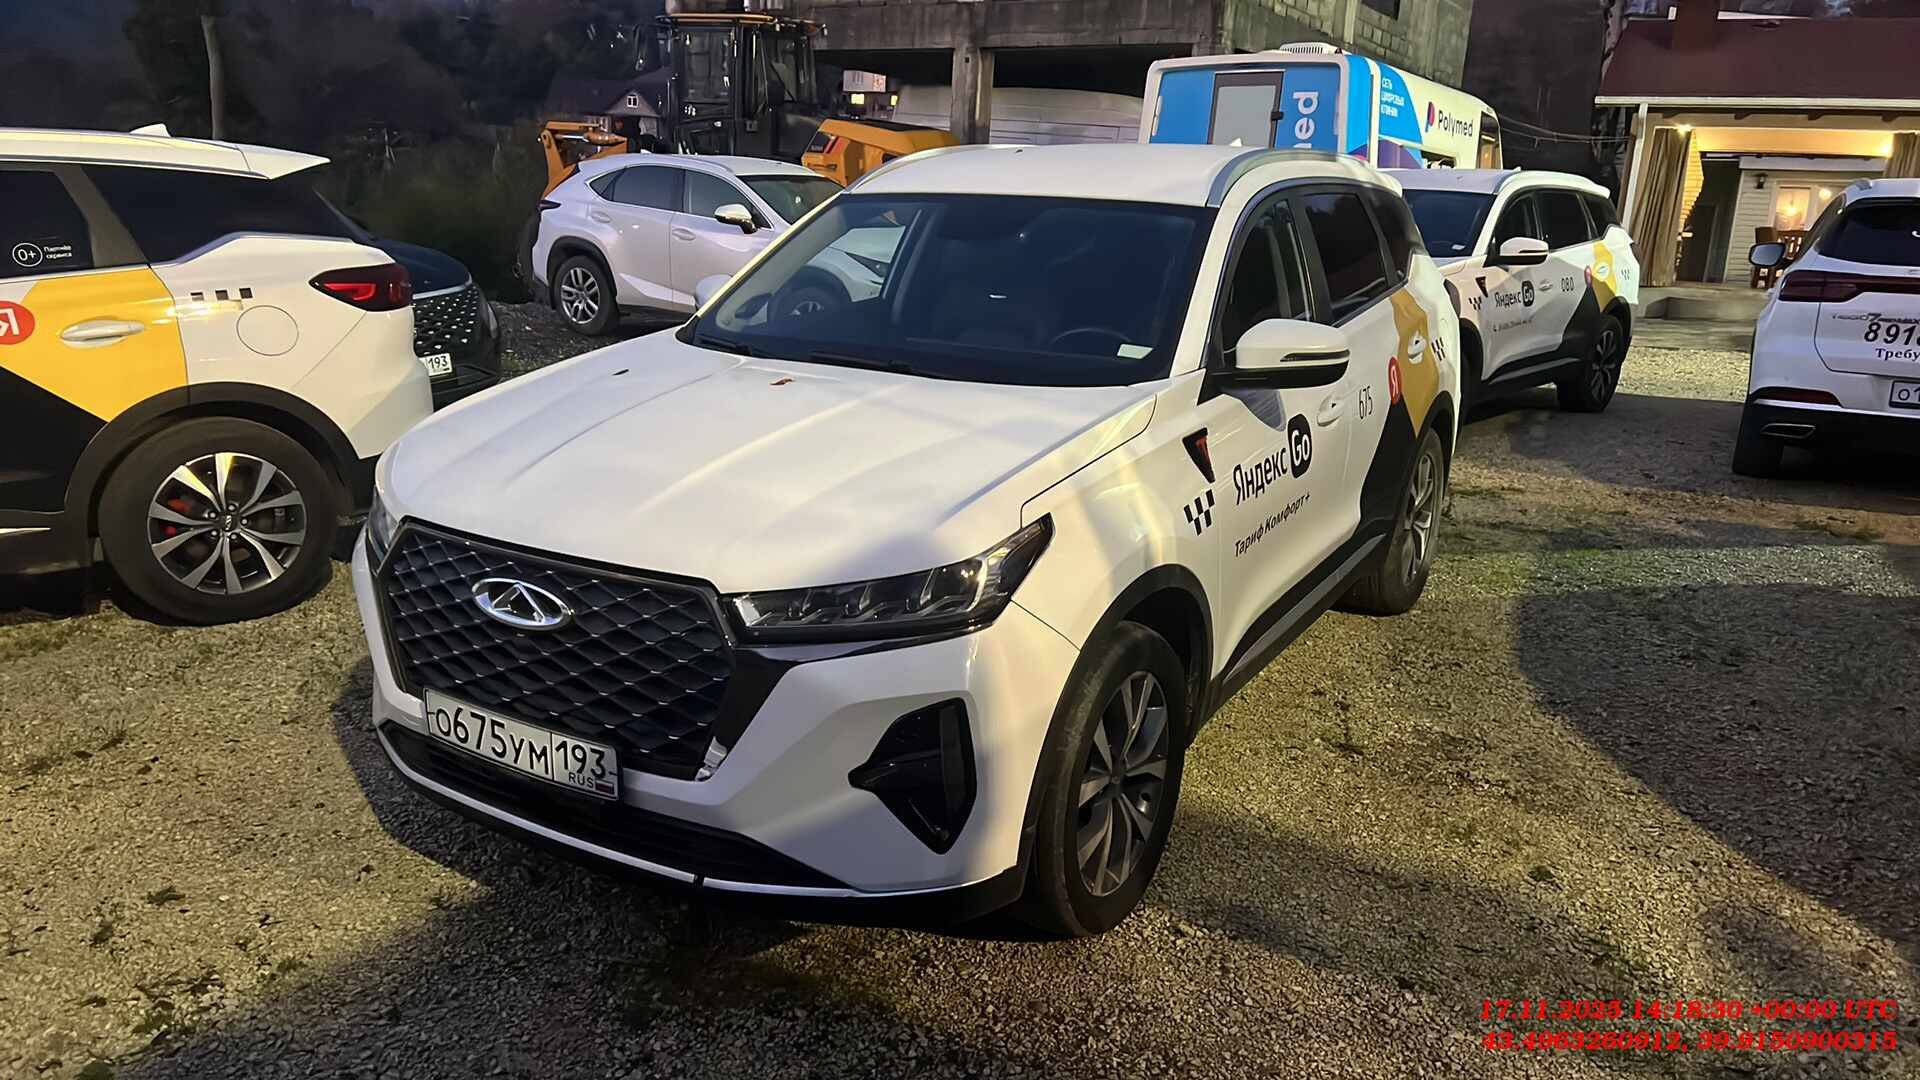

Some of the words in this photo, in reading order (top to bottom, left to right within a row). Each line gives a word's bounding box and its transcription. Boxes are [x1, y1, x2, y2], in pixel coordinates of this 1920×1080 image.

[1293, 92, 1318, 149] ed
[1438, 110, 1474, 137] Polymed
[1494, 289, 1521, 309] Яндекс
[1523, 285, 1533, 303] Go
[1864, 322, 1920, 347] 891
[428, 355, 448, 369] 193
[1391, 365, 1398, 397] Я
[1359, 385, 1373, 420] 675
[1233, 447, 1288, 506] Яндекс
[1291, 429, 1311, 468] Go
[1234, 523, 1264, 558] Тариф
[1264, 493, 1311, 532] Комфорт+
[555, 740, 606, 779] 193
[568, 771, 594, 789] RUS
